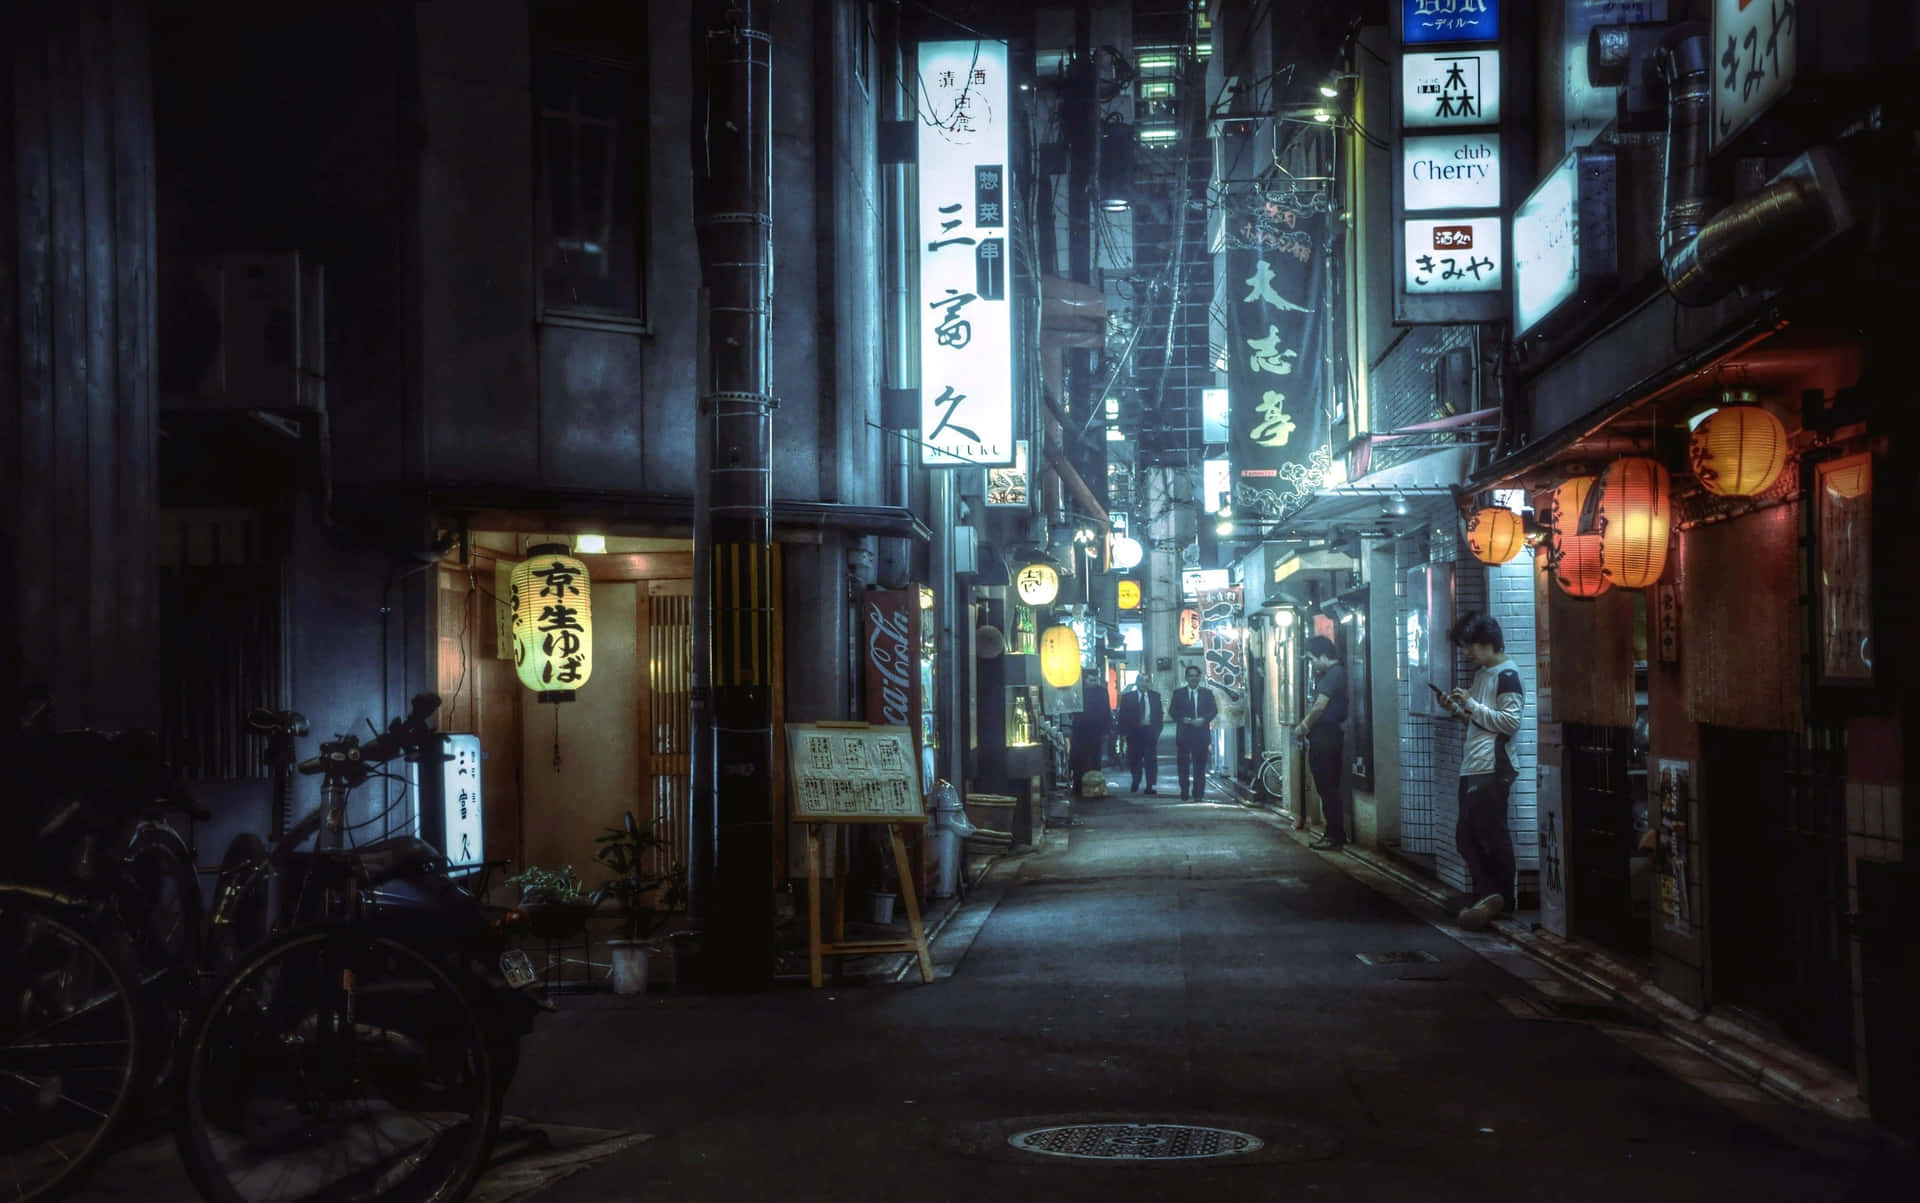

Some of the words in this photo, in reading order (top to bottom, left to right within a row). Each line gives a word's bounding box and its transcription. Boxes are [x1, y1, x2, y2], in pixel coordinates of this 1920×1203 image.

[1435, 62, 1475, 118] 森
[1412, 160, 1489, 182] Cherry
[1454, 144, 1491, 160] club
[1415, 254, 1495, 285] きみや
[927, 203, 979, 443] 三富久
[869, 600, 910, 726] ca-Cola
